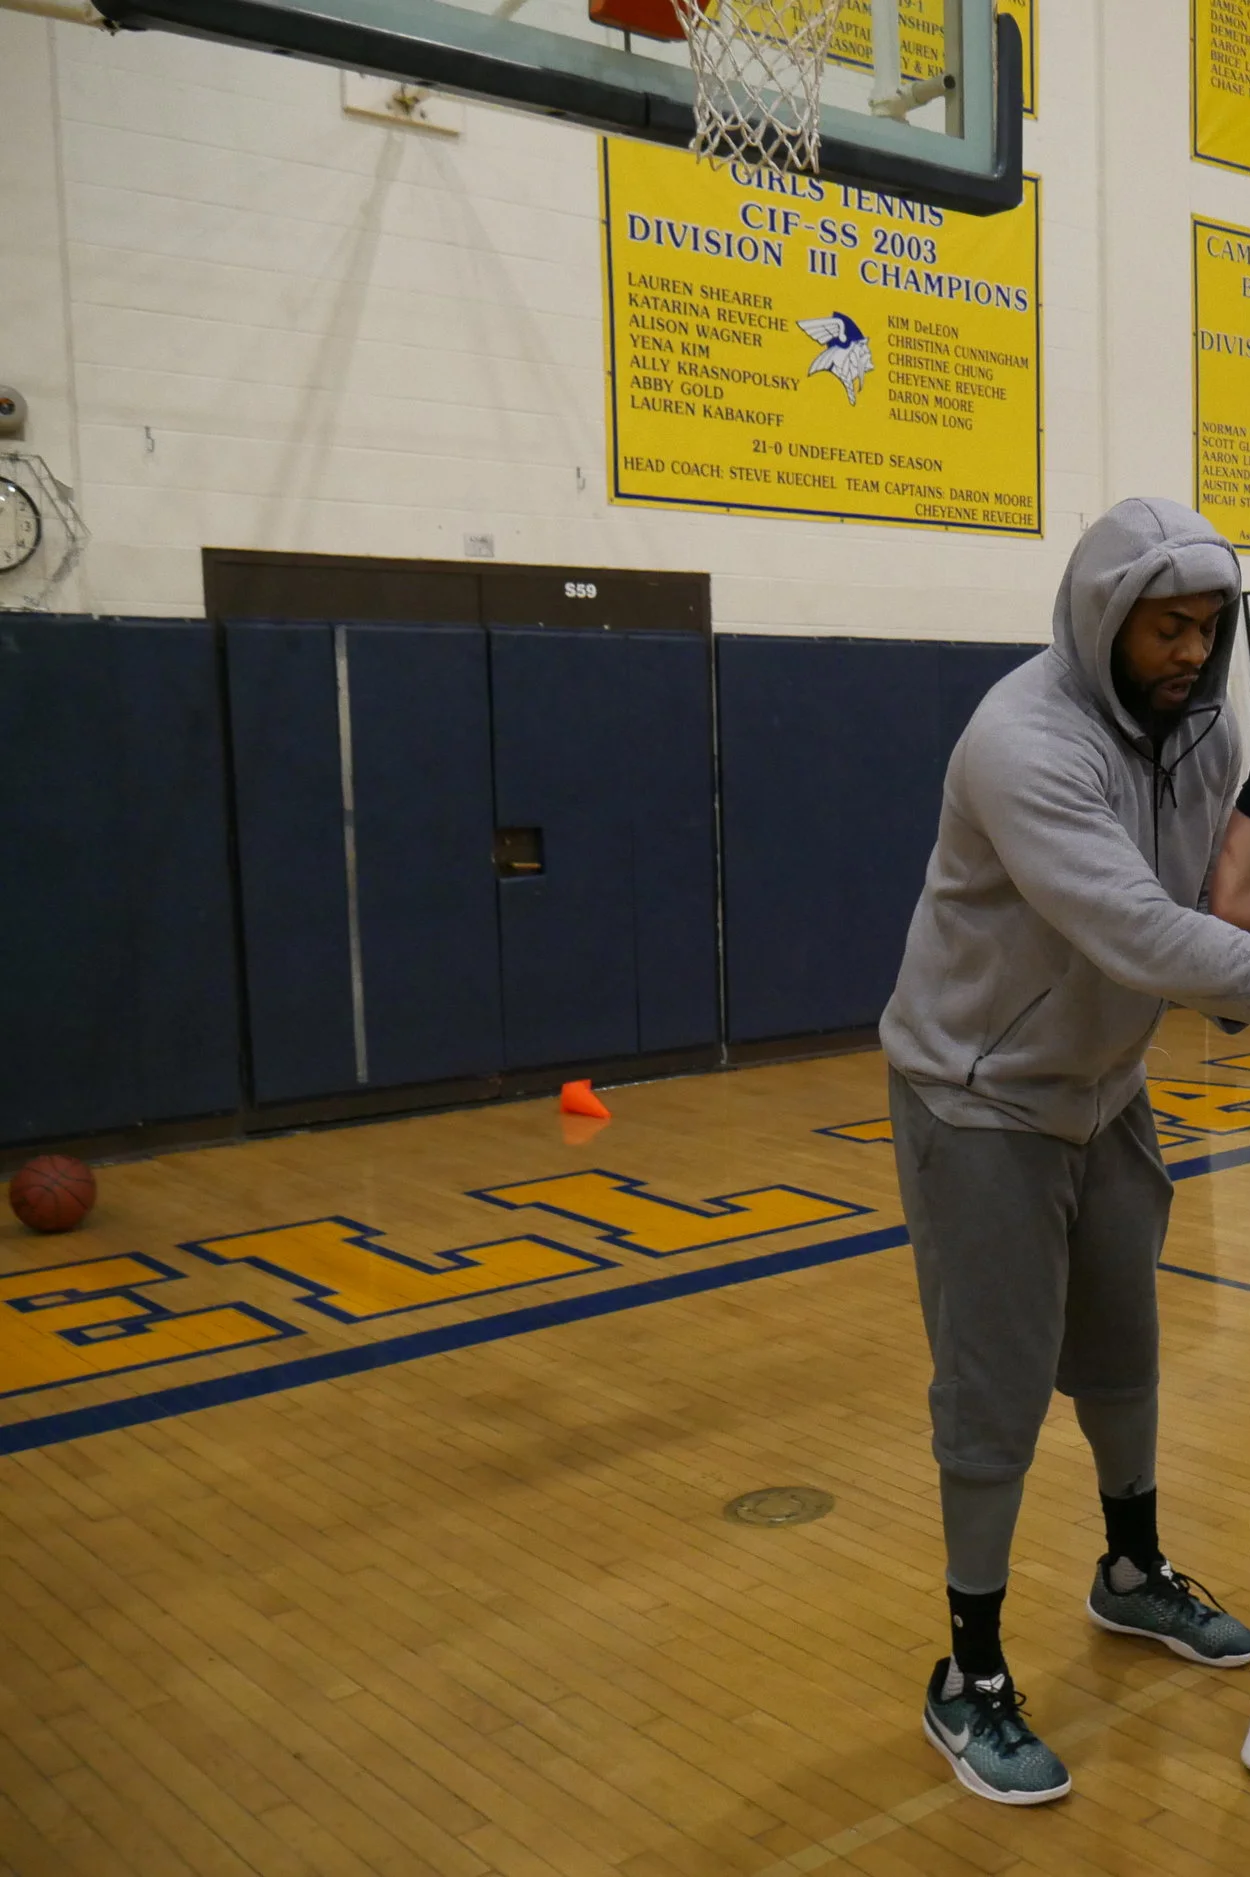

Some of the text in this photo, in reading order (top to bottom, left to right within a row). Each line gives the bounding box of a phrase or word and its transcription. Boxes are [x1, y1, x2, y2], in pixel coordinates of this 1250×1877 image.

[899, 39, 939, 61] AUREN
[731, 161, 944, 227] GIRLS TENNIS
[741, 203, 937, 264] CIF-SS 2003
[628, 214, 1029, 312] DIVISION III CHAMPIONS
[628, 272, 773, 310] LAUREN SHEARER
[628, 293, 789, 332] KATARINA REVECHE
[629, 315, 762, 348] ALISON WAGNER
[888, 316, 959, 339] KIM DeLEON
[629, 335, 710, 359] YENA KIM
[888, 335, 1029, 370] CHRISTINA CUNNINGHAM
[629, 355, 800, 392] ALLY KRASNOPOLSKY
[888, 353, 993, 381] CHRISTINE CHUNG
[630, 376, 724, 400] ABBY GOLD
[888, 371, 1007, 401] CHEYENNE REVECHE
[630, 395, 784, 427] LAUREN KABAKOFF
[889, 389, 974, 413] DARON MOORE
[889, 408, 973, 431] ALLISON LONG
[1202, 422, 1247, 437] NORMAN
[753, 440, 943, 473] 21-0 UNDEFEATED SEASON
[1202, 437, 1234, 450] SCOTT
[1203, 451, 1238, 465] AARON
[624, 456, 665, 473] HEAD
[730, 467, 771, 484] STEVE
[777, 471, 837, 489] KUECHEL
[846, 478, 879, 494] TEAM
[950, 488, 989, 505] DARON
[994, 492, 1033, 508] MOORE
[1203, 480, 1239, 492] AUSTIN
[1203, 494, 1236, 507] MICAH
[915, 503, 1034, 526] CHEYENNE REVECHE
[564, 582, 597, 599] S59
